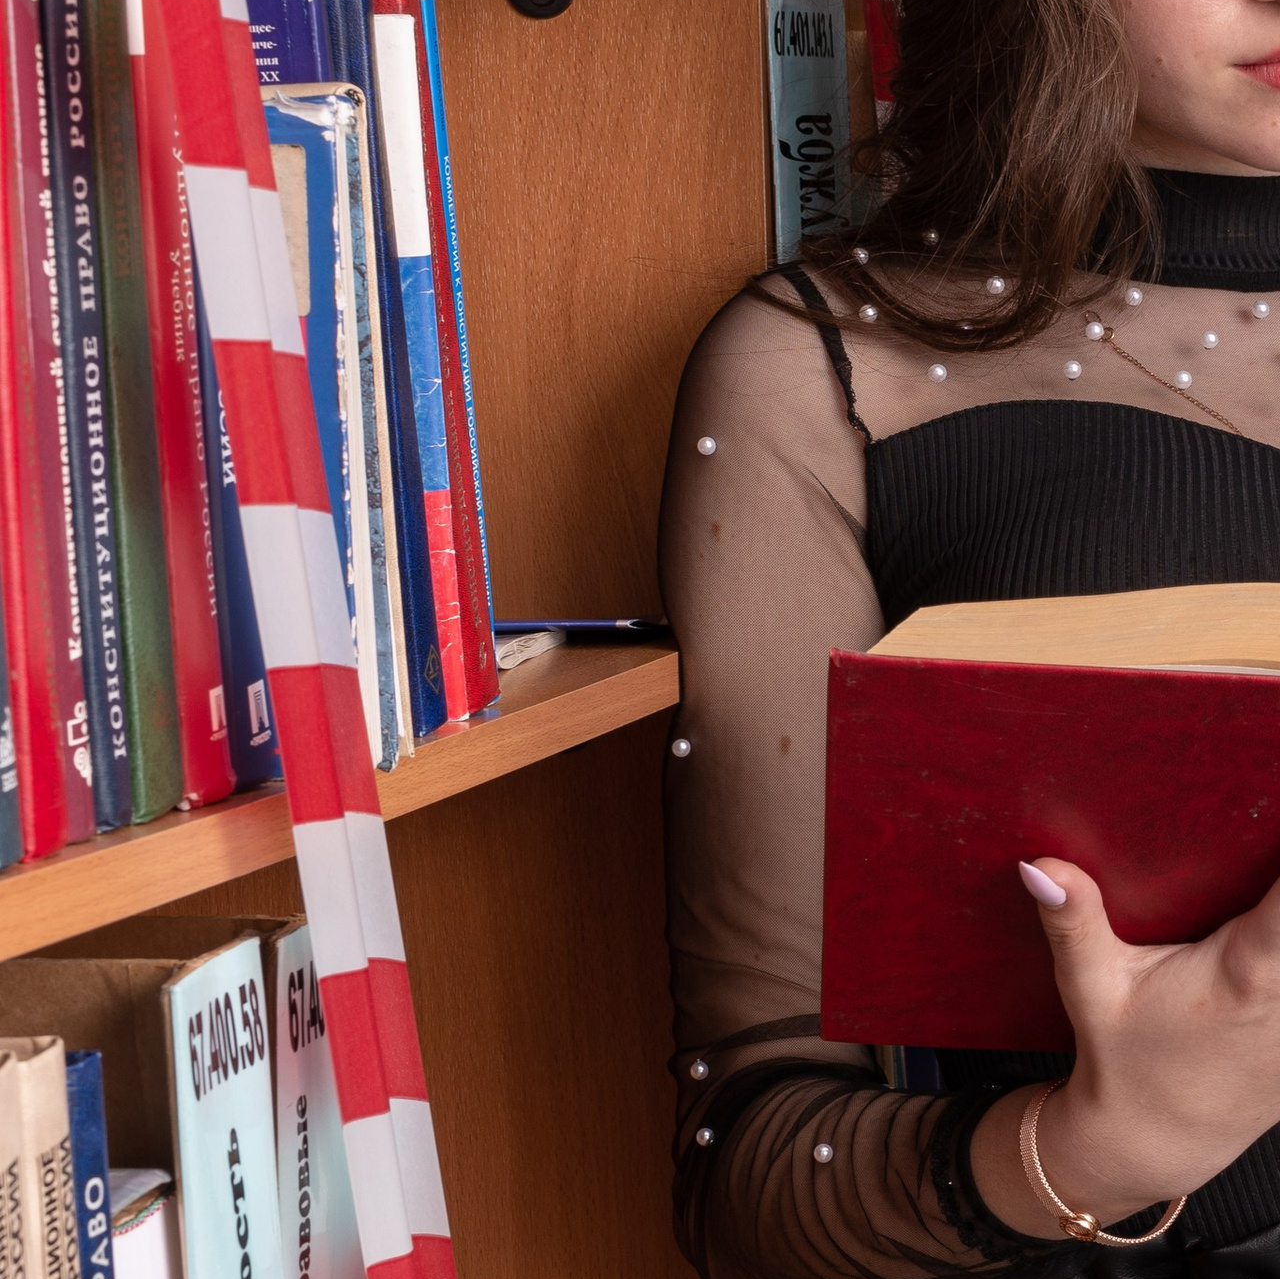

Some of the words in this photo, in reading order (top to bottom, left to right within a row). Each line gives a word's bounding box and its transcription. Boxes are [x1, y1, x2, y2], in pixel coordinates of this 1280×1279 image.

[73, 173, 96, 311] ПРАВО
[443, 155, 460, 271] КОММЕНТАРИЙ
[169, 247, 185, 363] Учебник
[454, 276, 461, 285] К
[455, 291, 472, 401] КОНСТИТУЦИИ
[187, 351, 205, 461] право
[466, 406, 483, 511] РОССИЙСКОЙ
[48, 357, 83, 660] Конституционный
[82, 335, 127, 760] КОНСТИТУЦИОННОЕ
[188, 978, 265, 1102] 67.400.58
